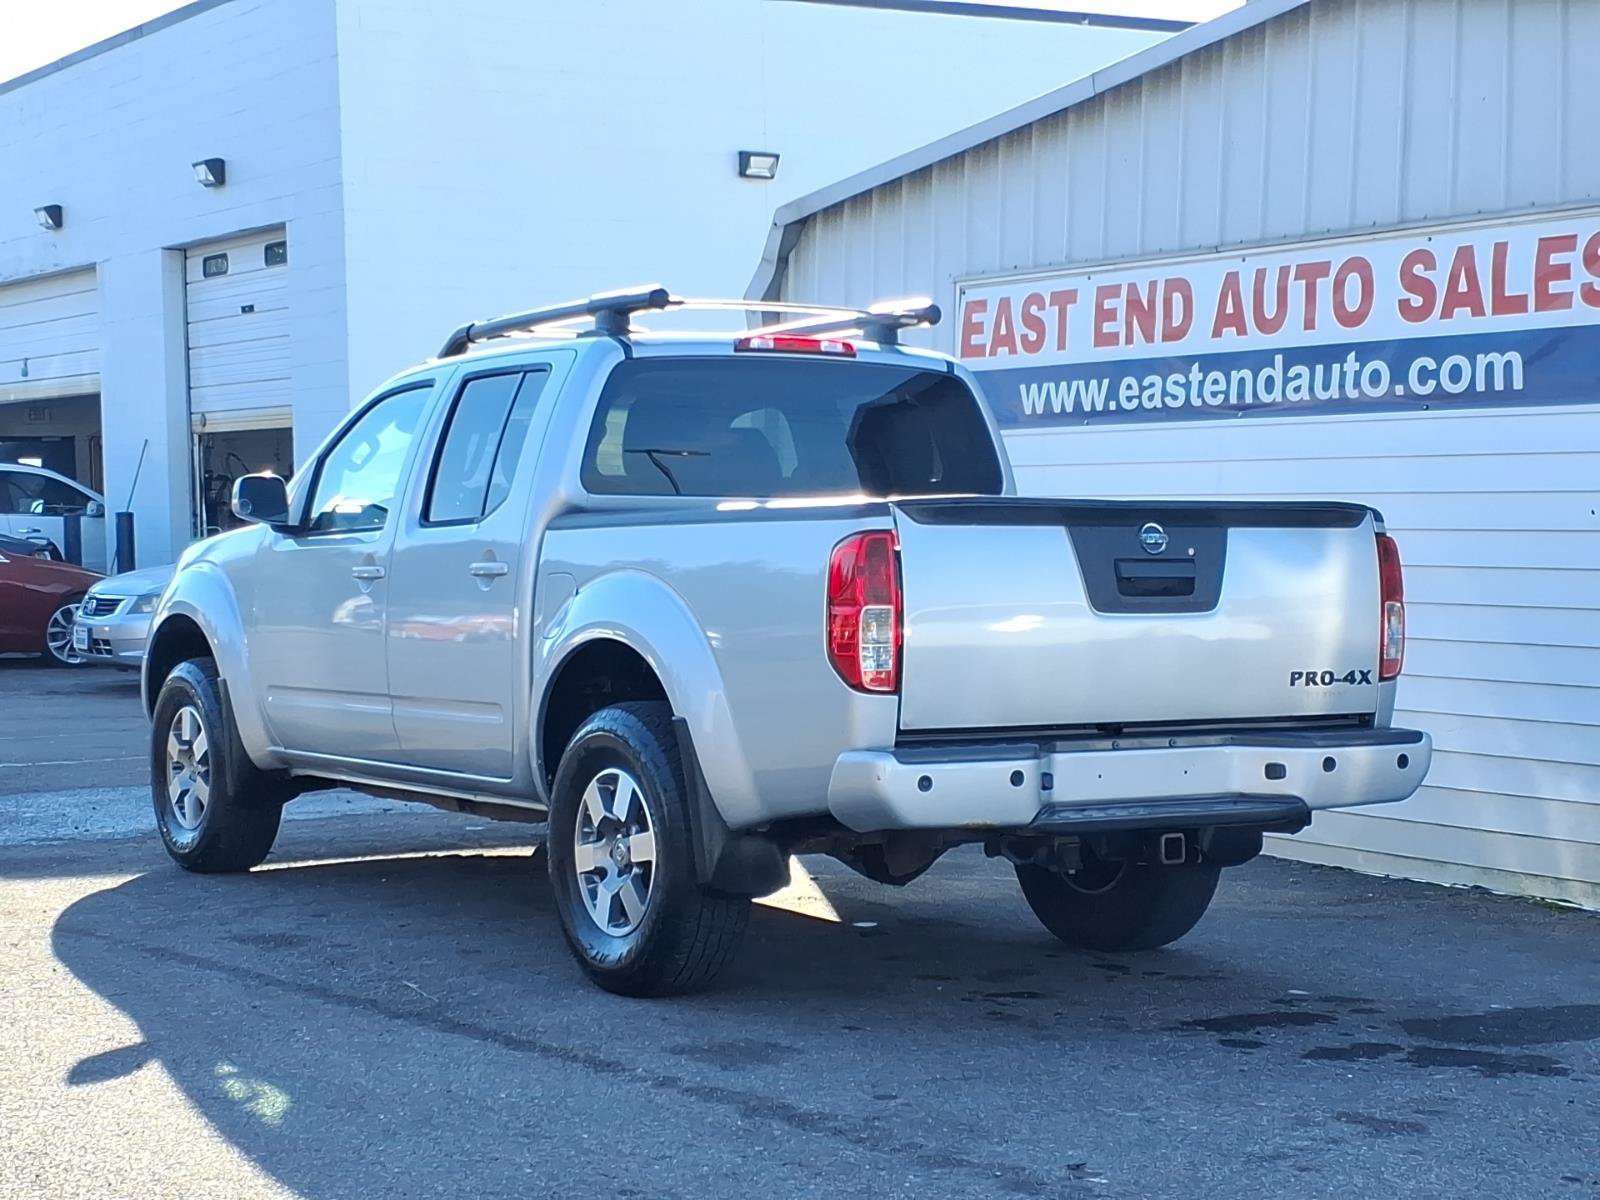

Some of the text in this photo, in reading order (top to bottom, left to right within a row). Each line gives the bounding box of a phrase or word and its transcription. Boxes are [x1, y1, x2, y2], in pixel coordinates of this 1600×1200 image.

[960, 289, 1079, 359] EAST
[1093, 276, 1194, 348] END
[1211, 256, 1375, 339] AUTO
[1019, 350, 1524, 415] www.eastendauto.com
[1289, 669, 1373, 687] PRO-4X
